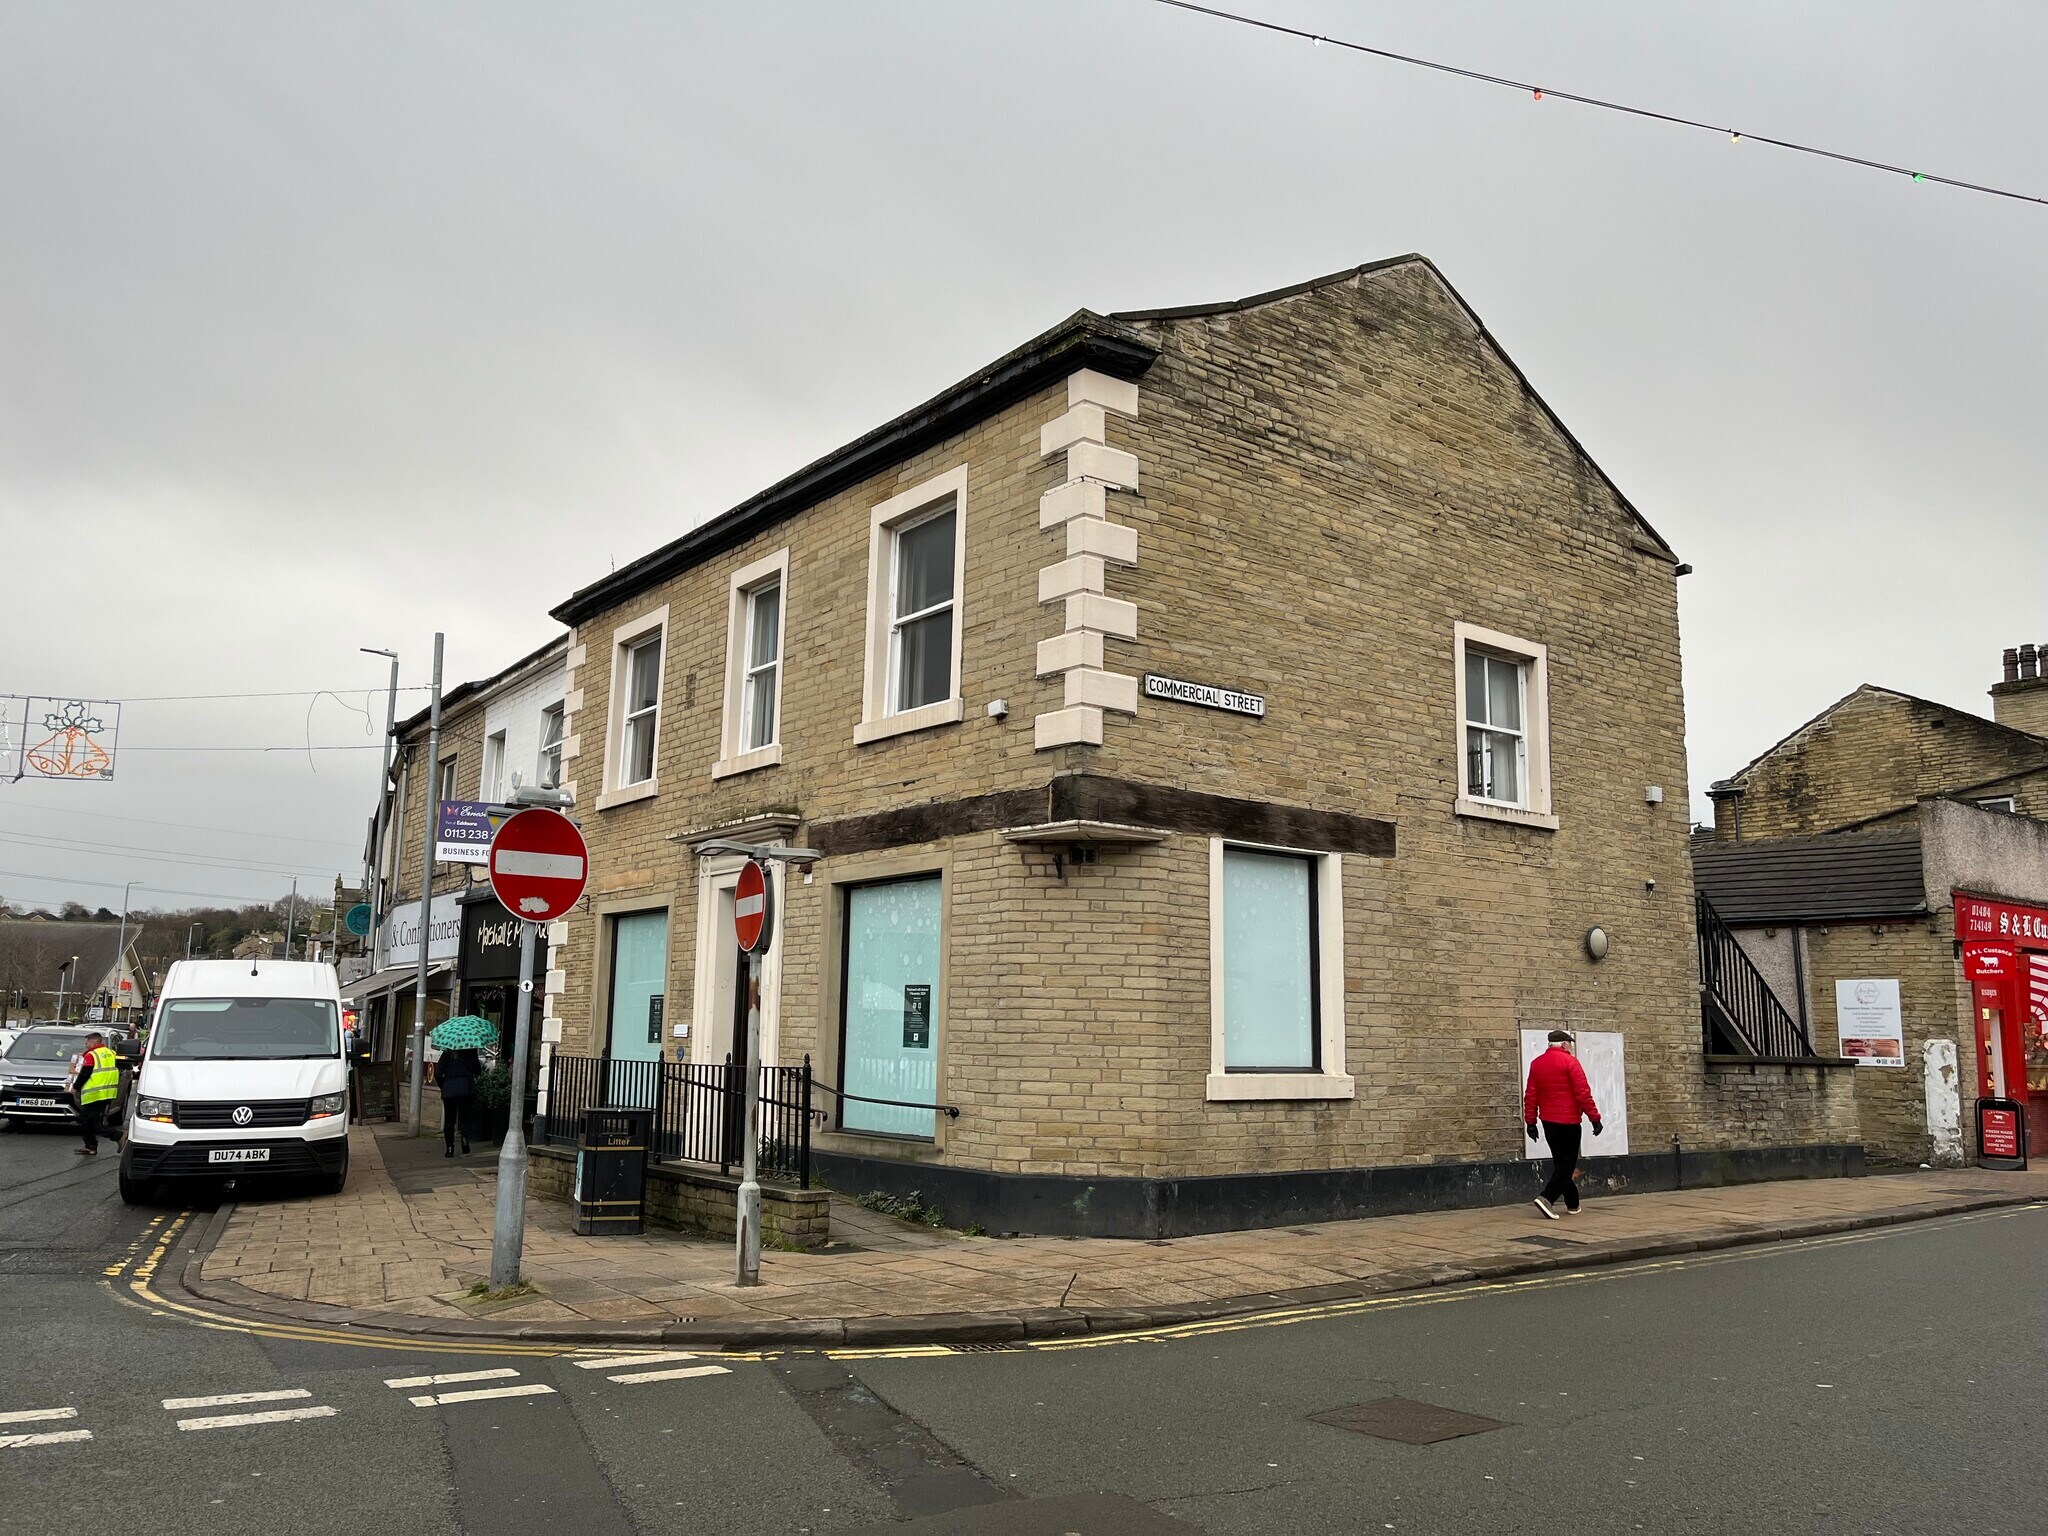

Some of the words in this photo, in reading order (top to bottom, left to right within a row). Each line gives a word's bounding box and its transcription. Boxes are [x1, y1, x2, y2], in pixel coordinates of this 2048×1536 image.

[1149, 678, 1218, 704] COMMERCIAL
[1224, 693, 1262, 712] STREET
[460, 805, 486, 817] Ernes
[444, 828, 466, 838] 0113
[468, 829, 489, 840] 238
[442, 847, 480, 857] BUSINESS
[1971, 904, 1991, 918] 01484
[1970, 919, 1992, 932] 714149
[1999, 911, 2009, 934] S
[2012, 913, 2020, 936] &
[2022, 915, 2032, 937] L
[2033, 917, 2048, 939] Cu
[391, 924, 399, 948] &
[400, 915, 460, 947] Conftioners
[1983, 947, 2013, 957] Custance
[607, 1137, 631, 1146] Litter
[214, 1151, 242, 1161] DU74
[245, 1149, 266, 1160] ABK
